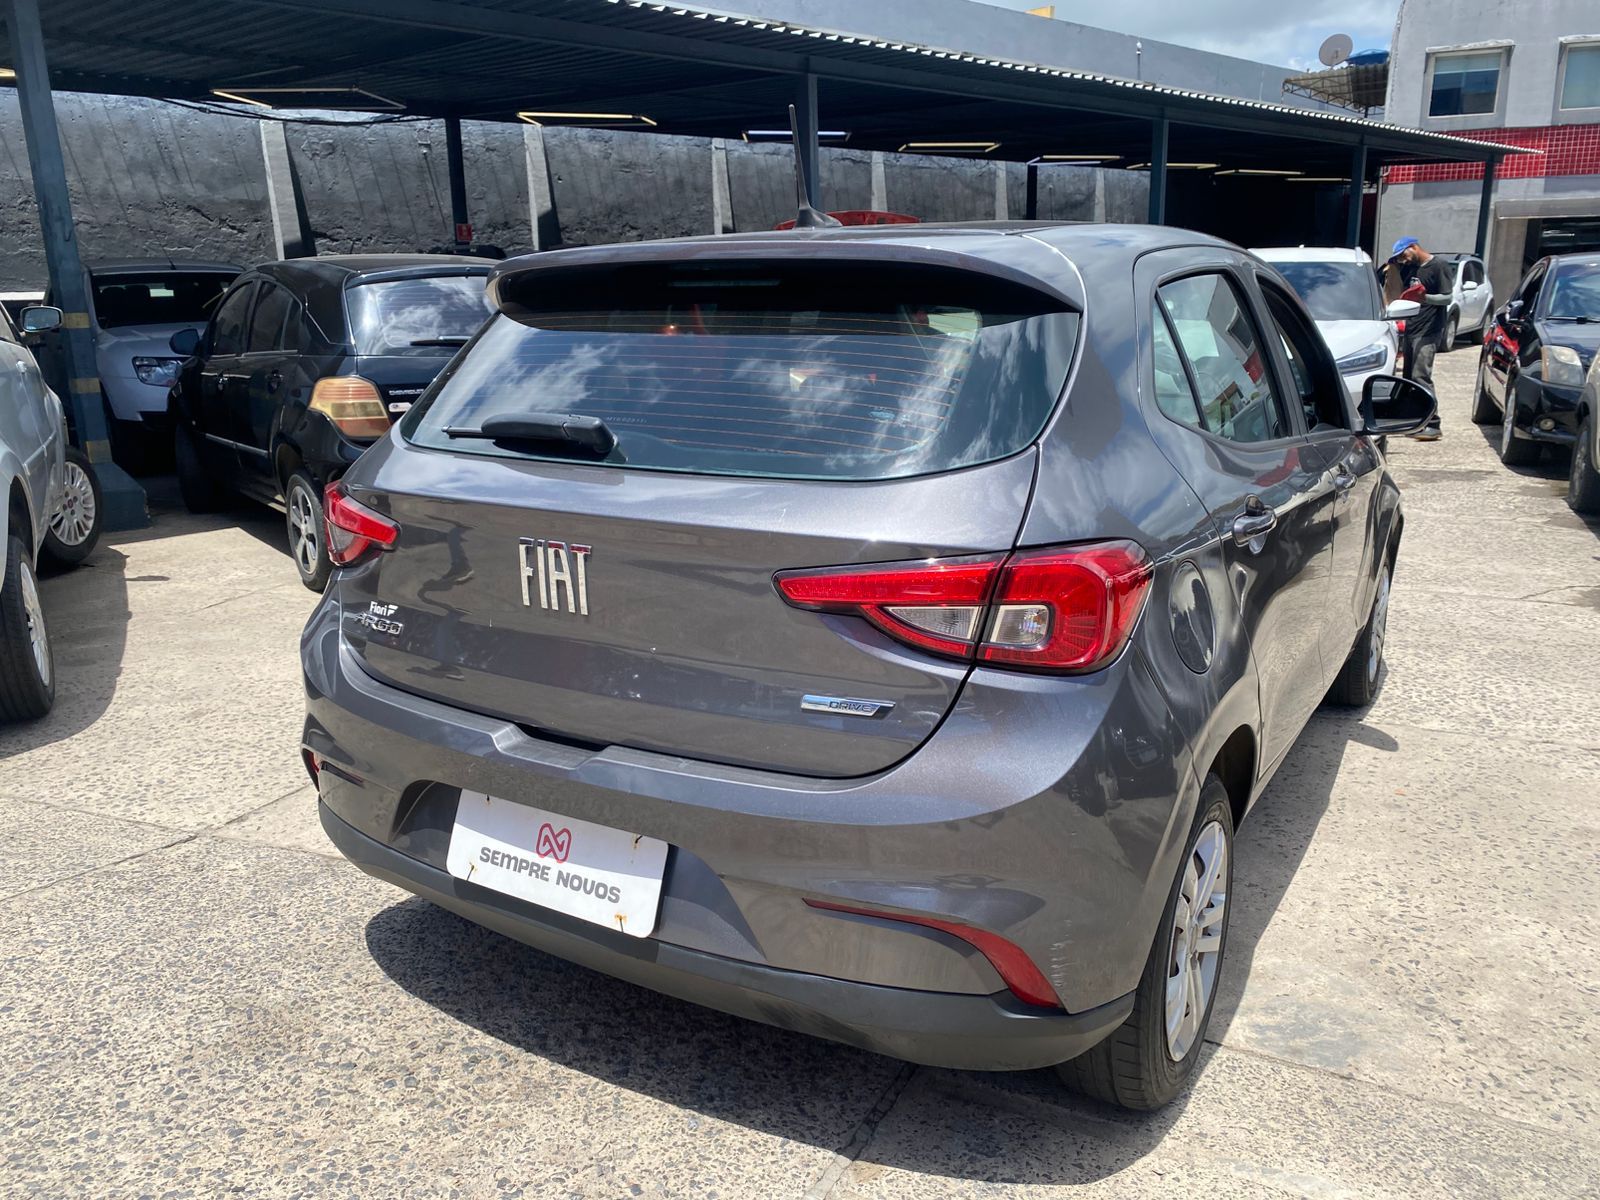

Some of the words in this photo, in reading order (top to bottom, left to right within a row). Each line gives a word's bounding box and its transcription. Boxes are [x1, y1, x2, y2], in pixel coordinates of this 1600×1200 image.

[519, 536, 592, 616] FIAT
[369, 600, 388, 617] Fiori
[354, 612, 404, 635] ARGO
[828, 700, 875, 713] DRIVE
[479, 847, 551, 882] SEMPRE
